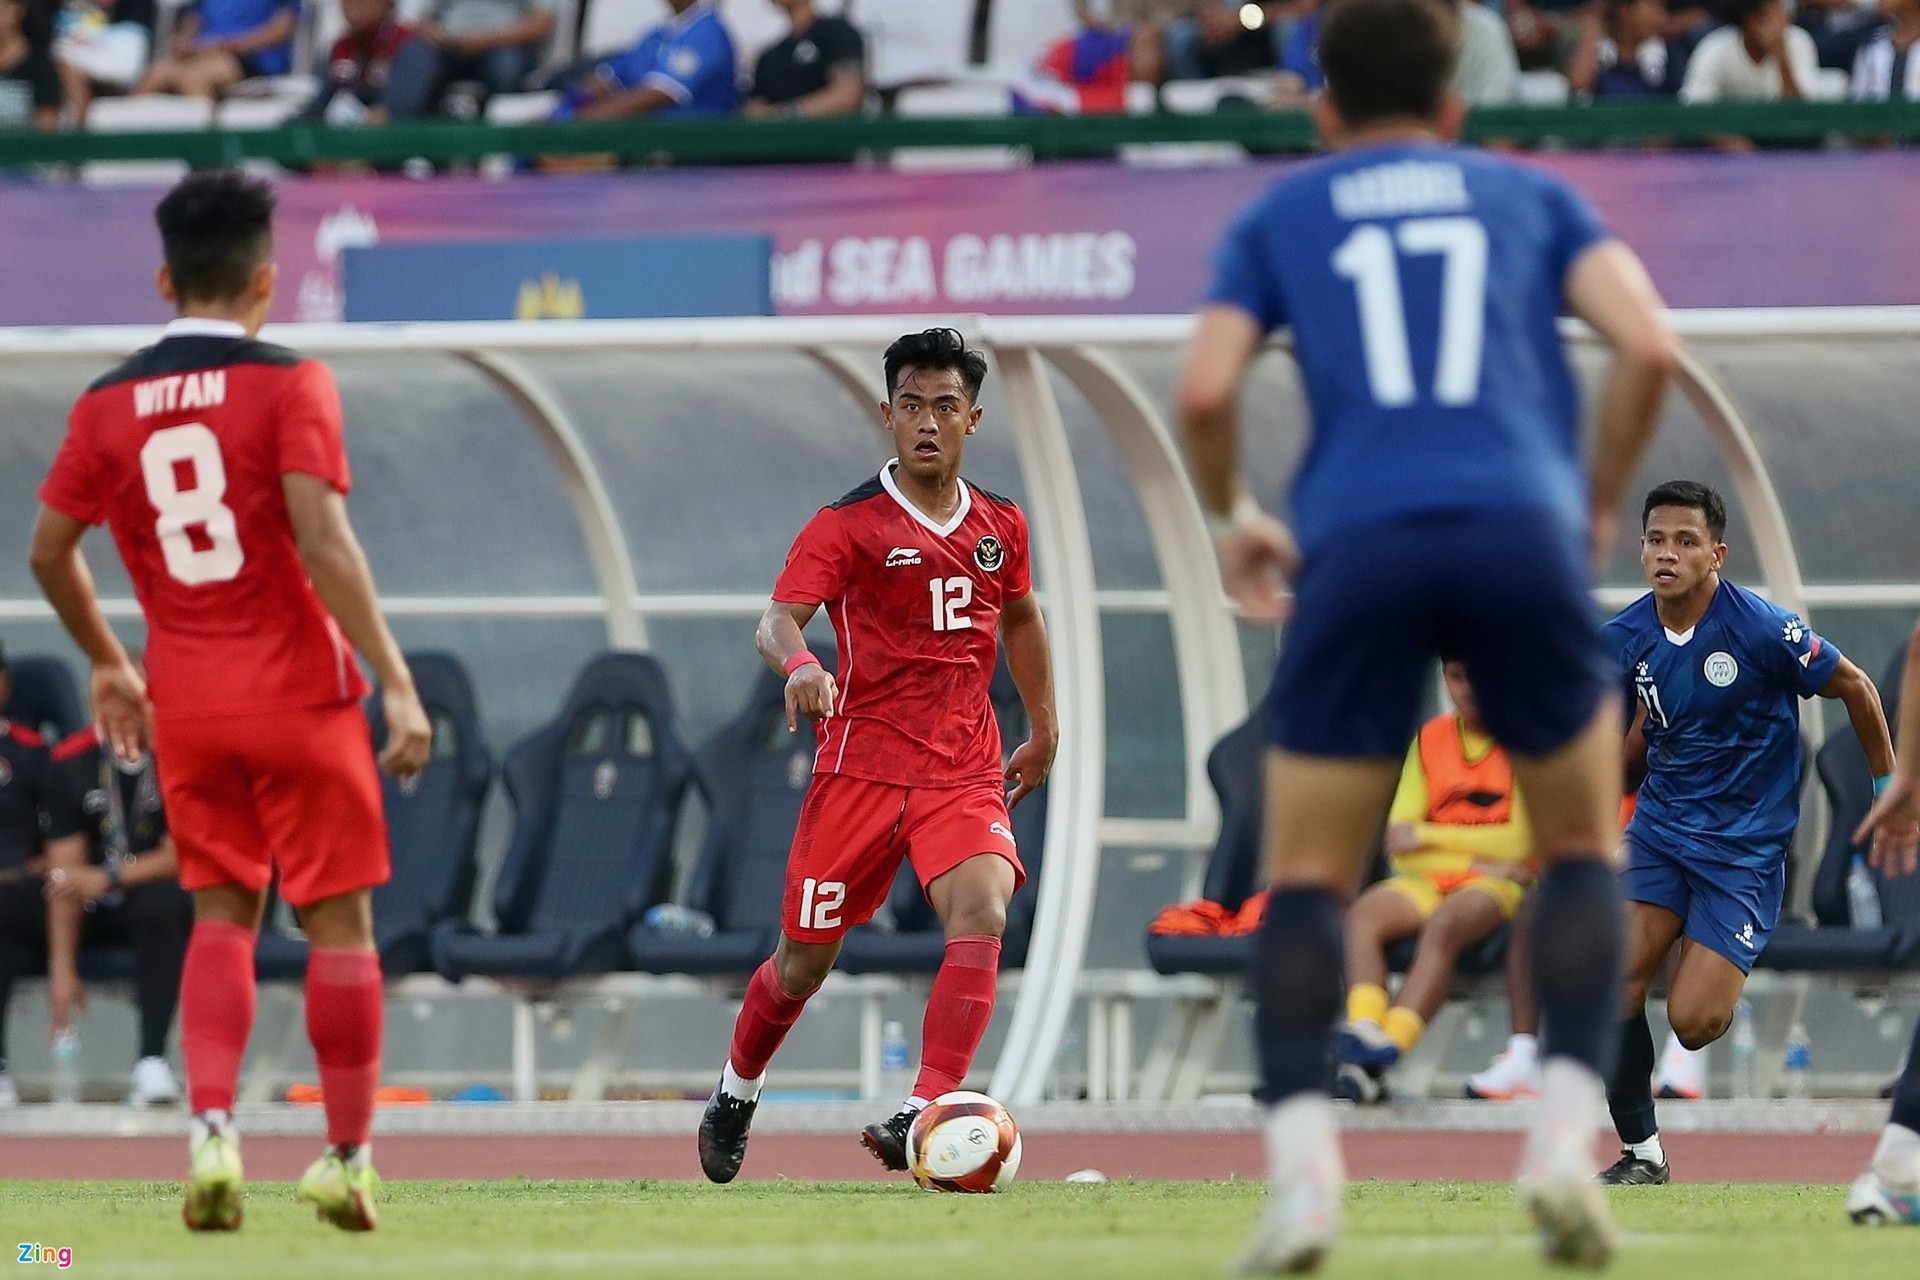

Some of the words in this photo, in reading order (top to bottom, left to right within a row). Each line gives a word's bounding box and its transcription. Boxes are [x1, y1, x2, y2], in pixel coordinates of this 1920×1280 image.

[827, 235, 938, 303] SEA
[944, 230, 1137, 302] GAMES
[1330, 216, 1489, 409] 17
[133, 369, 228, 418] WITAN
[139, 421, 246, 587] 8
[885, 557, 922, 567] LI-NING
[929, 576, 973, 632] 12
[799, 878, 846, 929] 12
